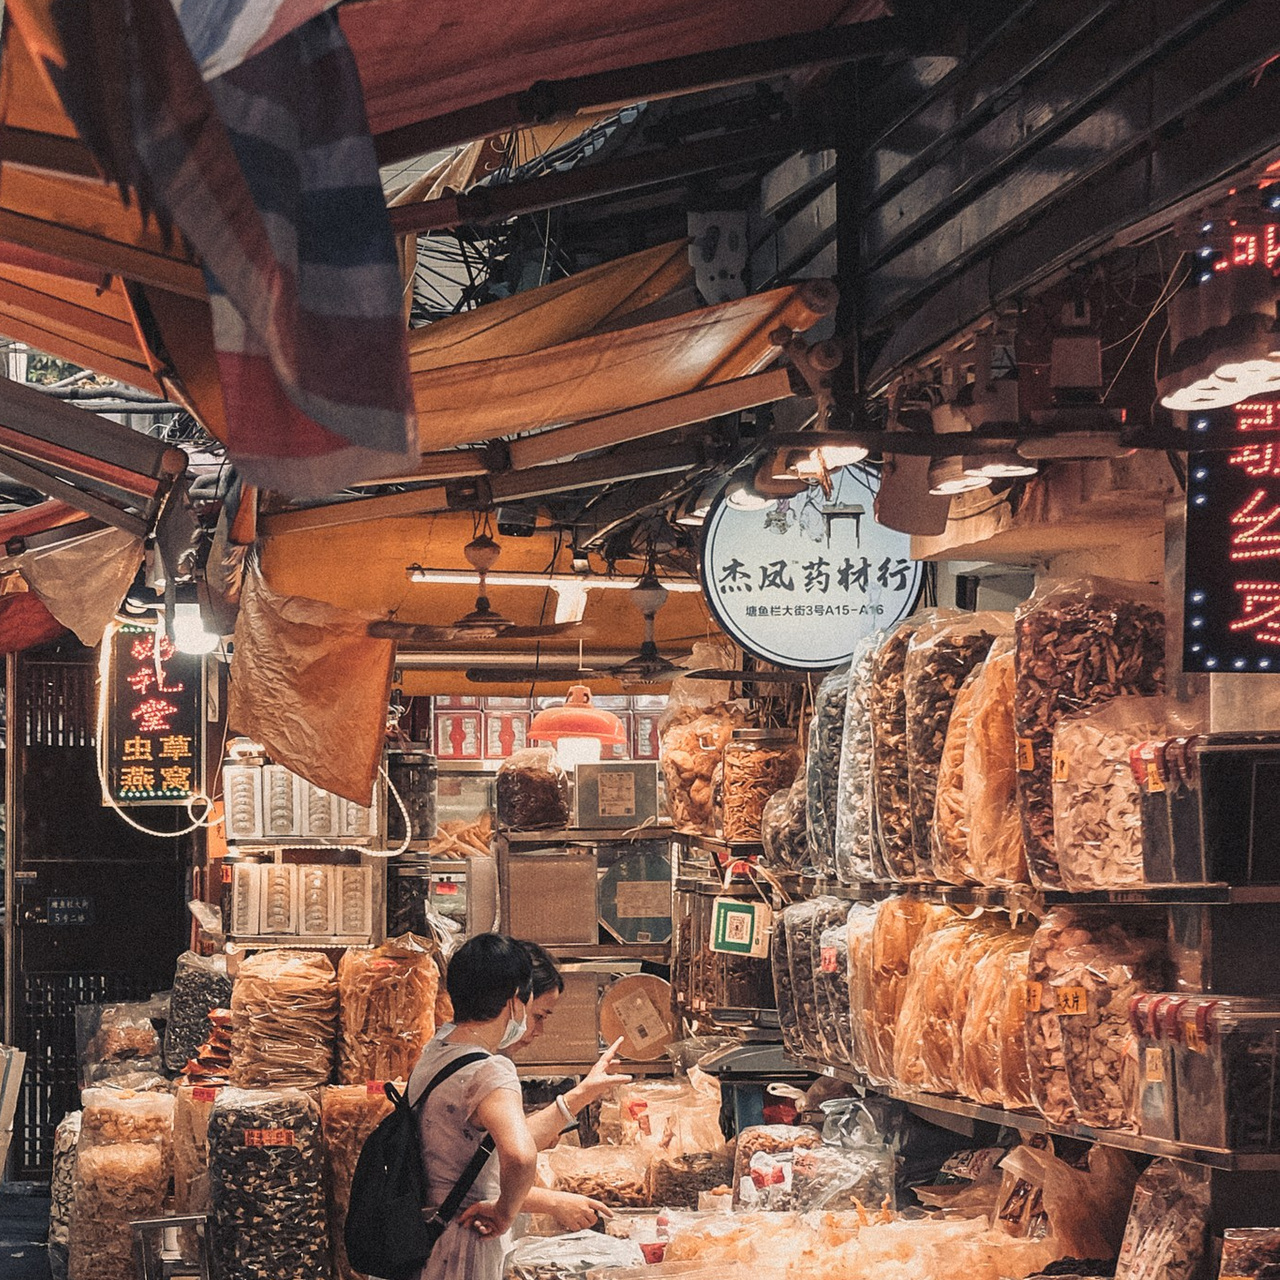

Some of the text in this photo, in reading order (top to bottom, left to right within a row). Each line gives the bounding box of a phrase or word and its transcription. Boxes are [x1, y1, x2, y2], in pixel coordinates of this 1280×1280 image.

[718, 555, 912, 595] 杰凤药材行
[121, 734, 193, 762] 虫草
[120, 765, 193, 792] 燕窝
